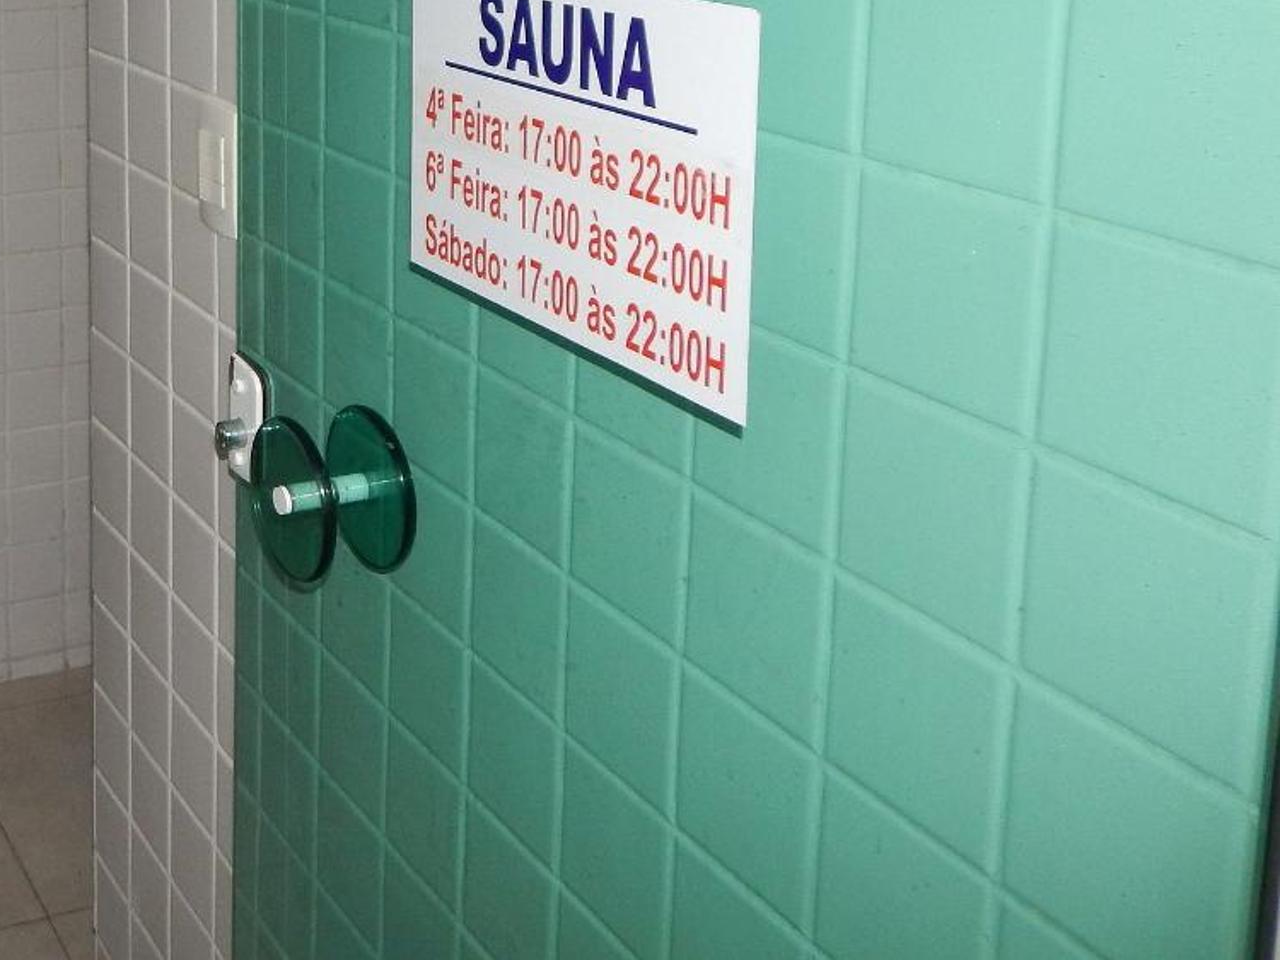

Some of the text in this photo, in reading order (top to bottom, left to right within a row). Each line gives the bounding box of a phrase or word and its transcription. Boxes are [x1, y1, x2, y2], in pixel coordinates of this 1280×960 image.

[426, 87, 731, 229] 4ª Feira: 17:00 às 22:00H
[426, 150, 728, 312] 6ª Feira: 17:00 às 22:00H
[425, 213, 726, 394] Sábado: 17:00 às 22:00H
